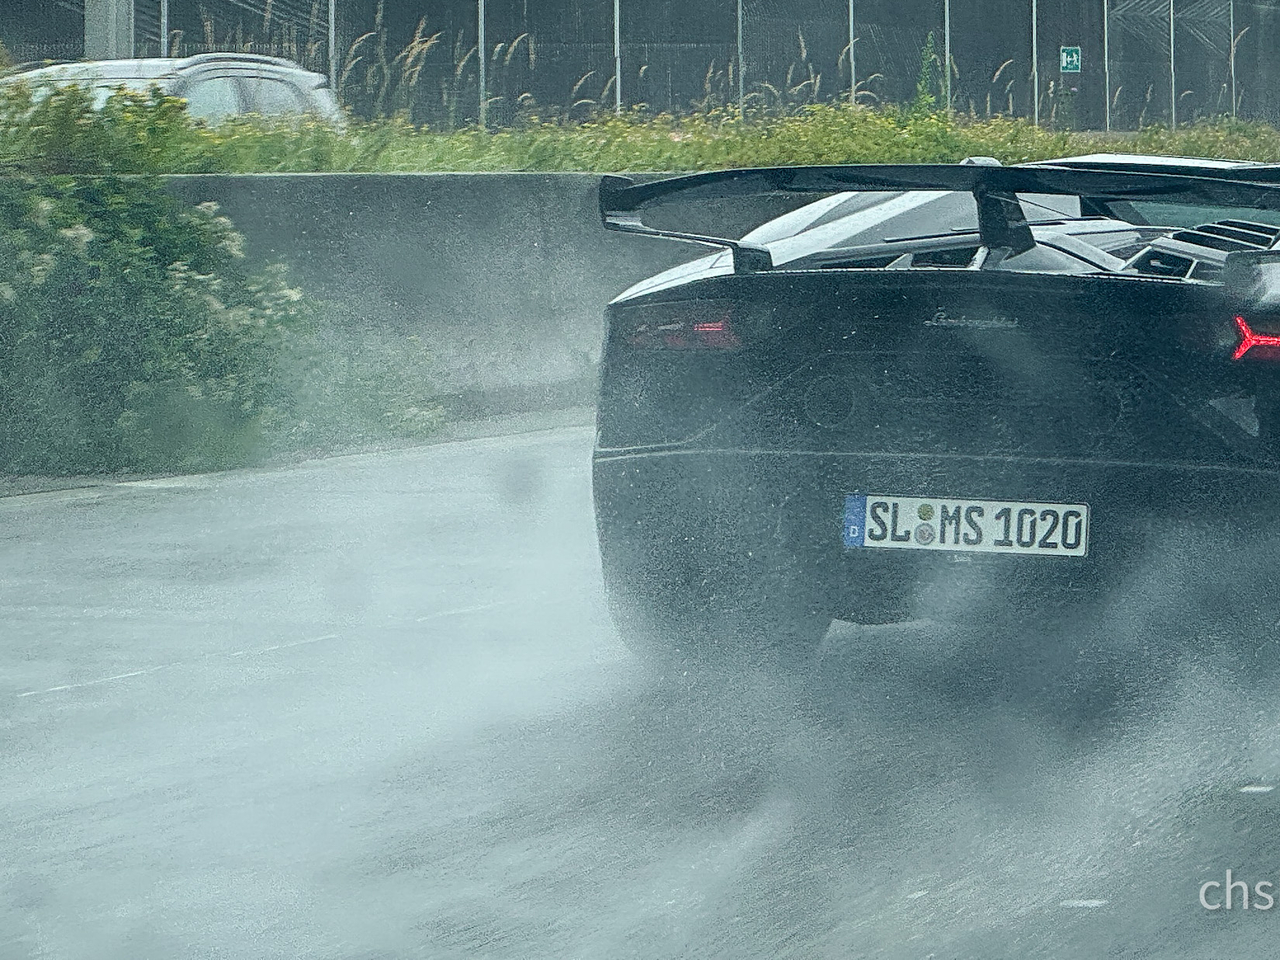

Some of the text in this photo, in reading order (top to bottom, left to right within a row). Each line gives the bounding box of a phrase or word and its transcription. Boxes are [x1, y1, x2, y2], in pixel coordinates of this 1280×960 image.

[850, 526, 858, 537] D
[867, 501, 1082, 550] SL MS 1020
